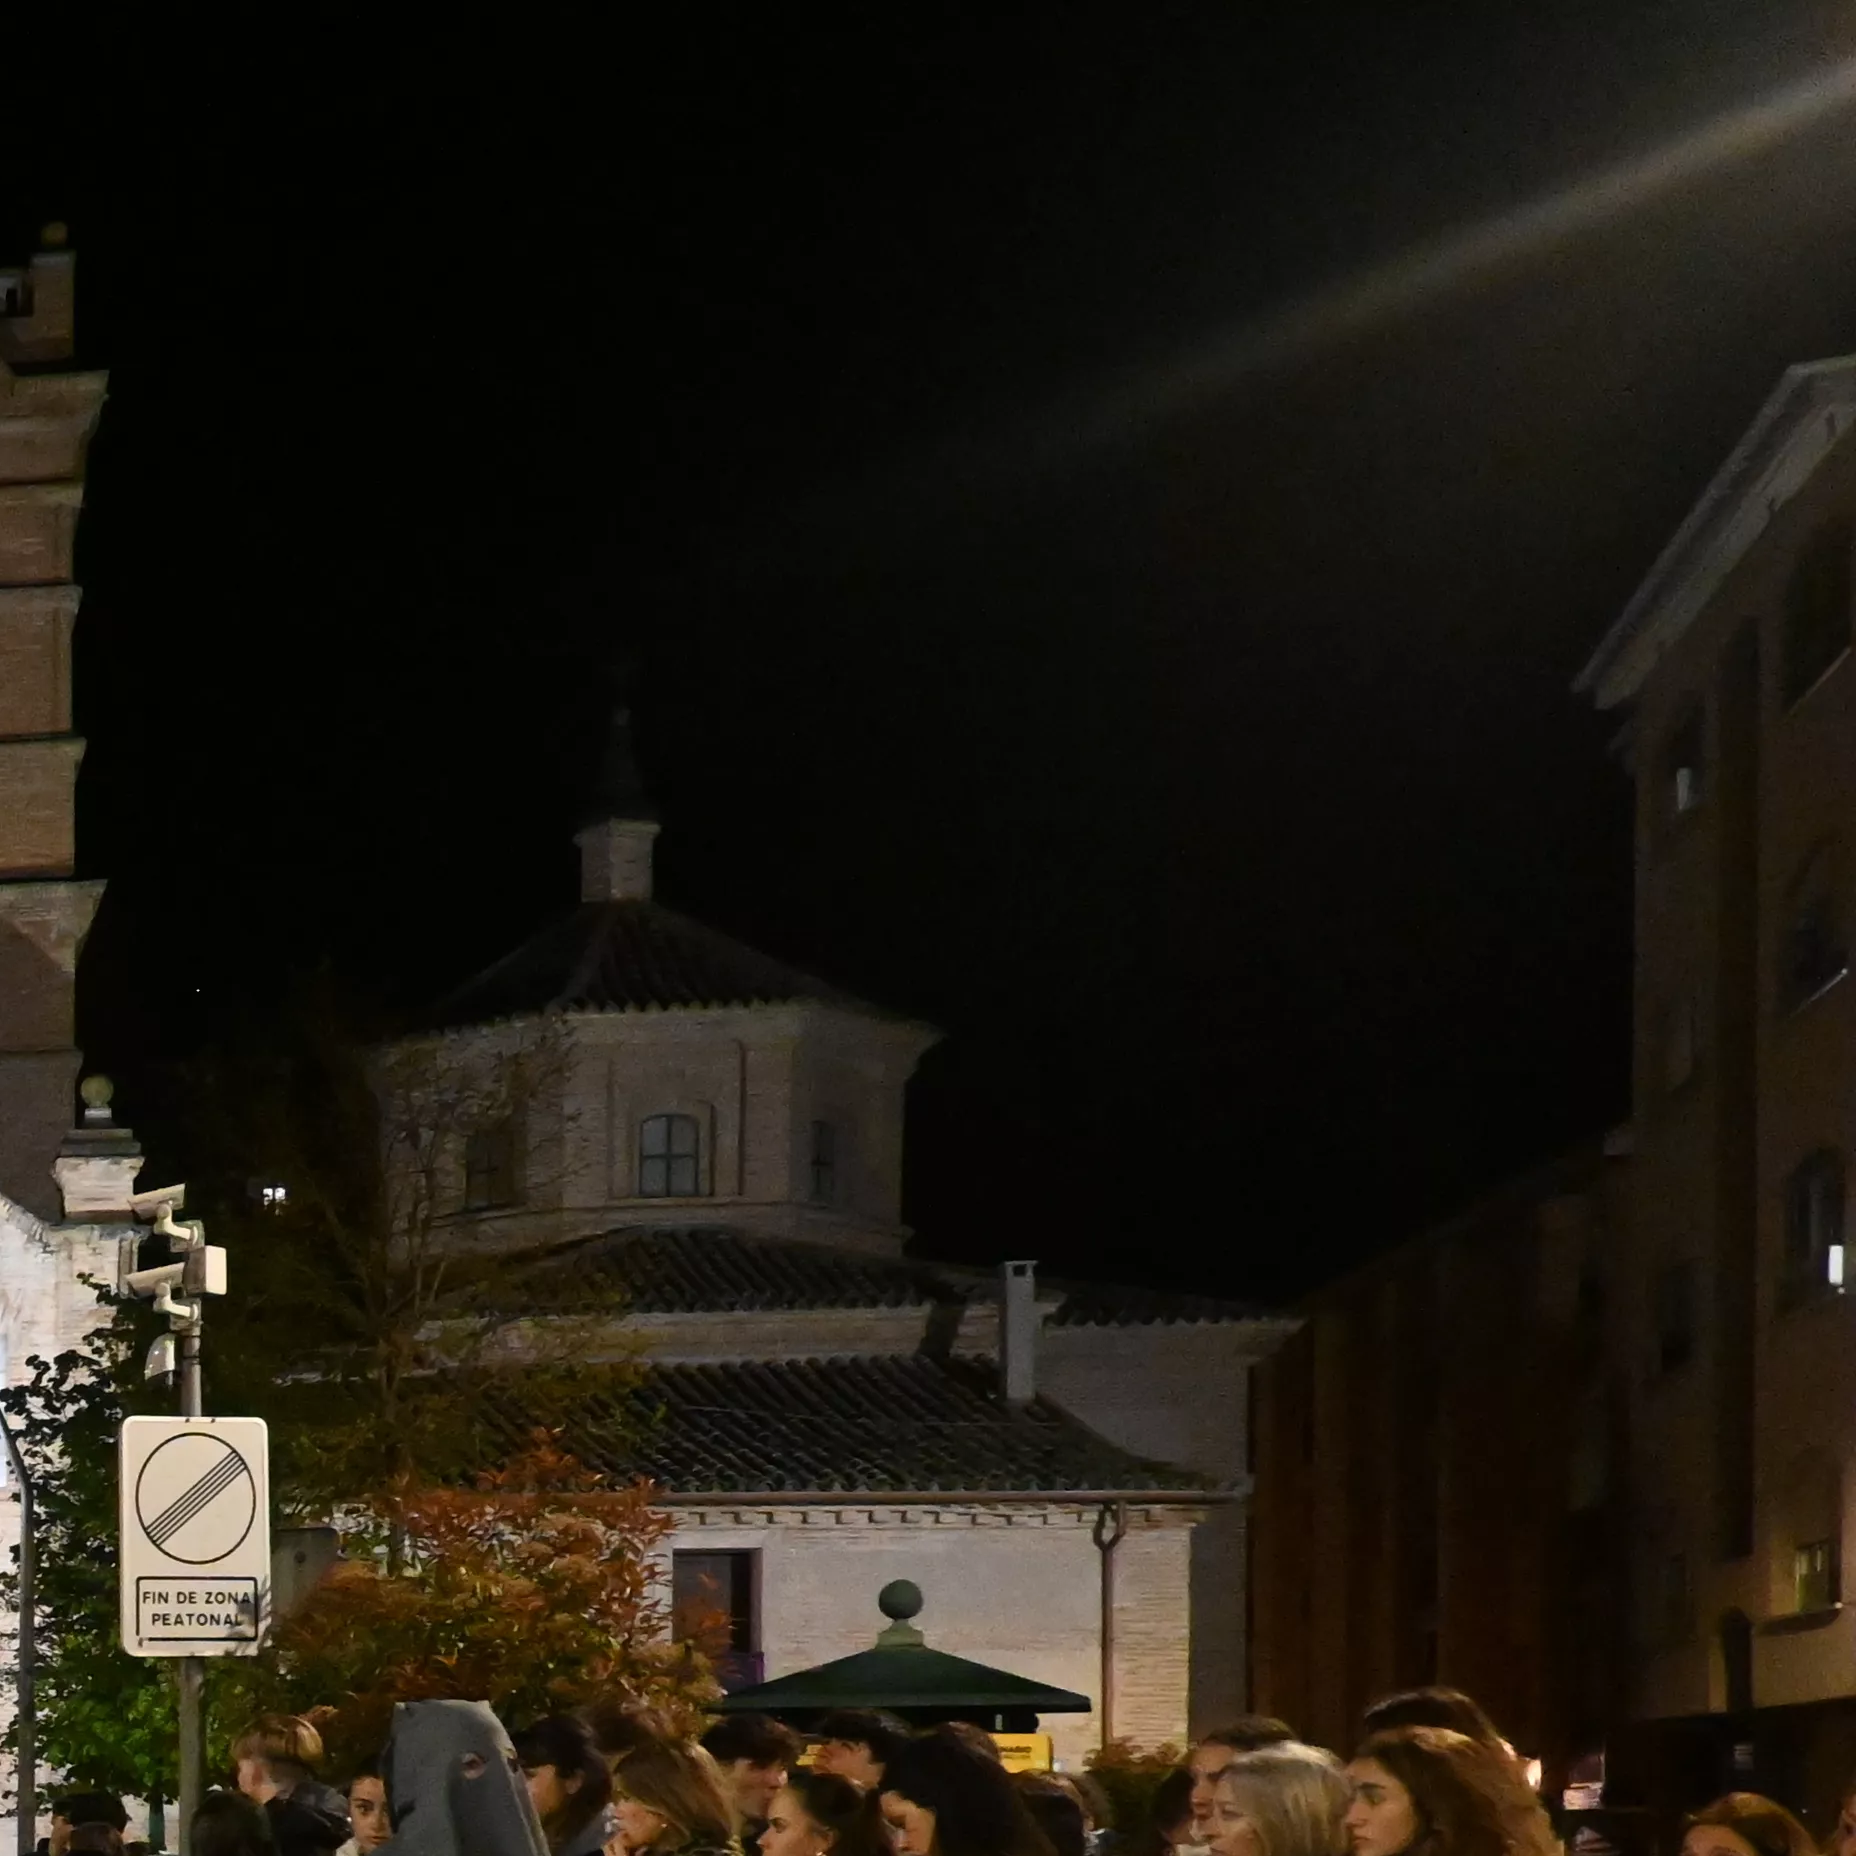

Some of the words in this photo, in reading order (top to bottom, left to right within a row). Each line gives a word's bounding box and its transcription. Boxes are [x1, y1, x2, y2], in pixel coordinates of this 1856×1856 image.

[142, 1591, 169, 1604] FIN
[176, 1591, 197, 1604] DE
[205, 1591, 251, 1604] ZONA
[151, 1613, 242, 1627] PEATONAL
